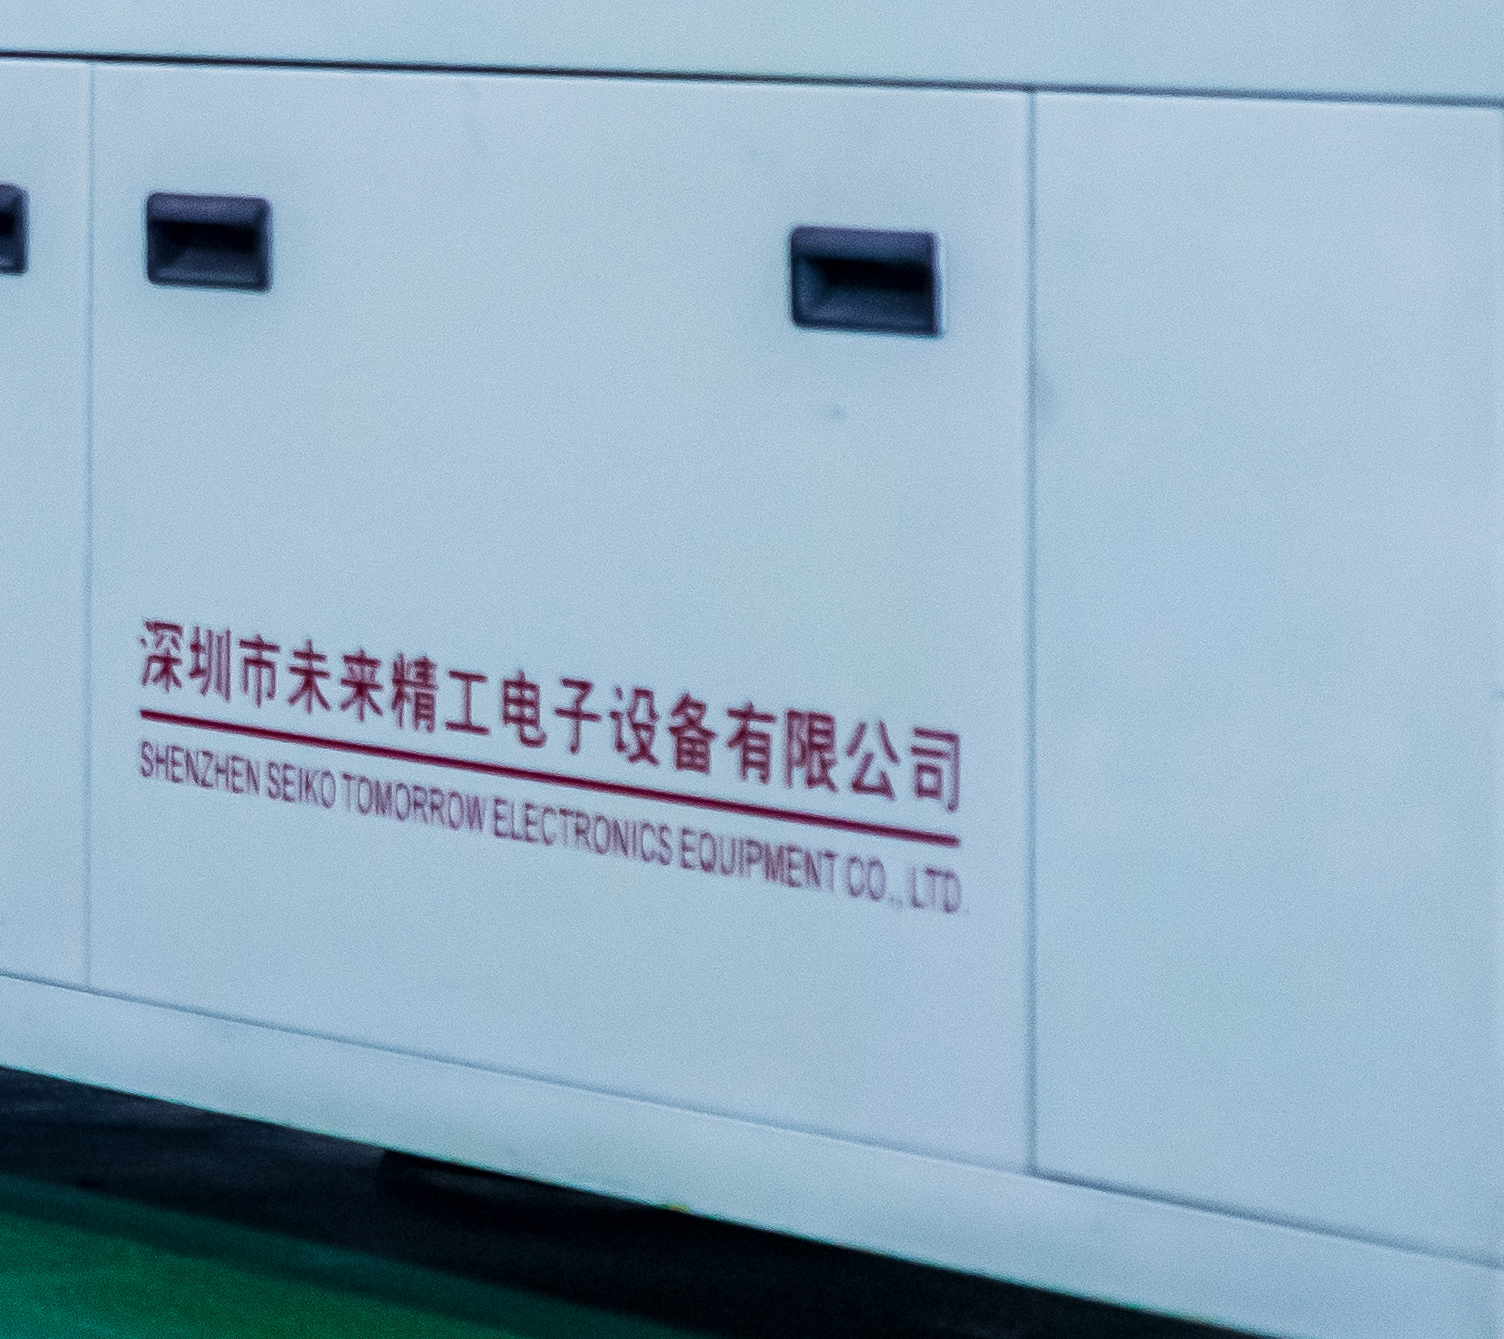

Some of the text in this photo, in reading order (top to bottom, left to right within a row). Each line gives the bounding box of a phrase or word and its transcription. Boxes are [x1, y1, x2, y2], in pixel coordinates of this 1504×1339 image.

[140, 619, 963, 814] 深圳市未来精工电子设备有限公司
[139, 739, 261, 795] SHENZHEN
[265, 759, 337, 810] SEIKO
[341, 772, 486, 832] TOMORROW
[492, 795, 673, 867] ELECTRONICS
[679, 825, 839, 894] EQUIPMENT
